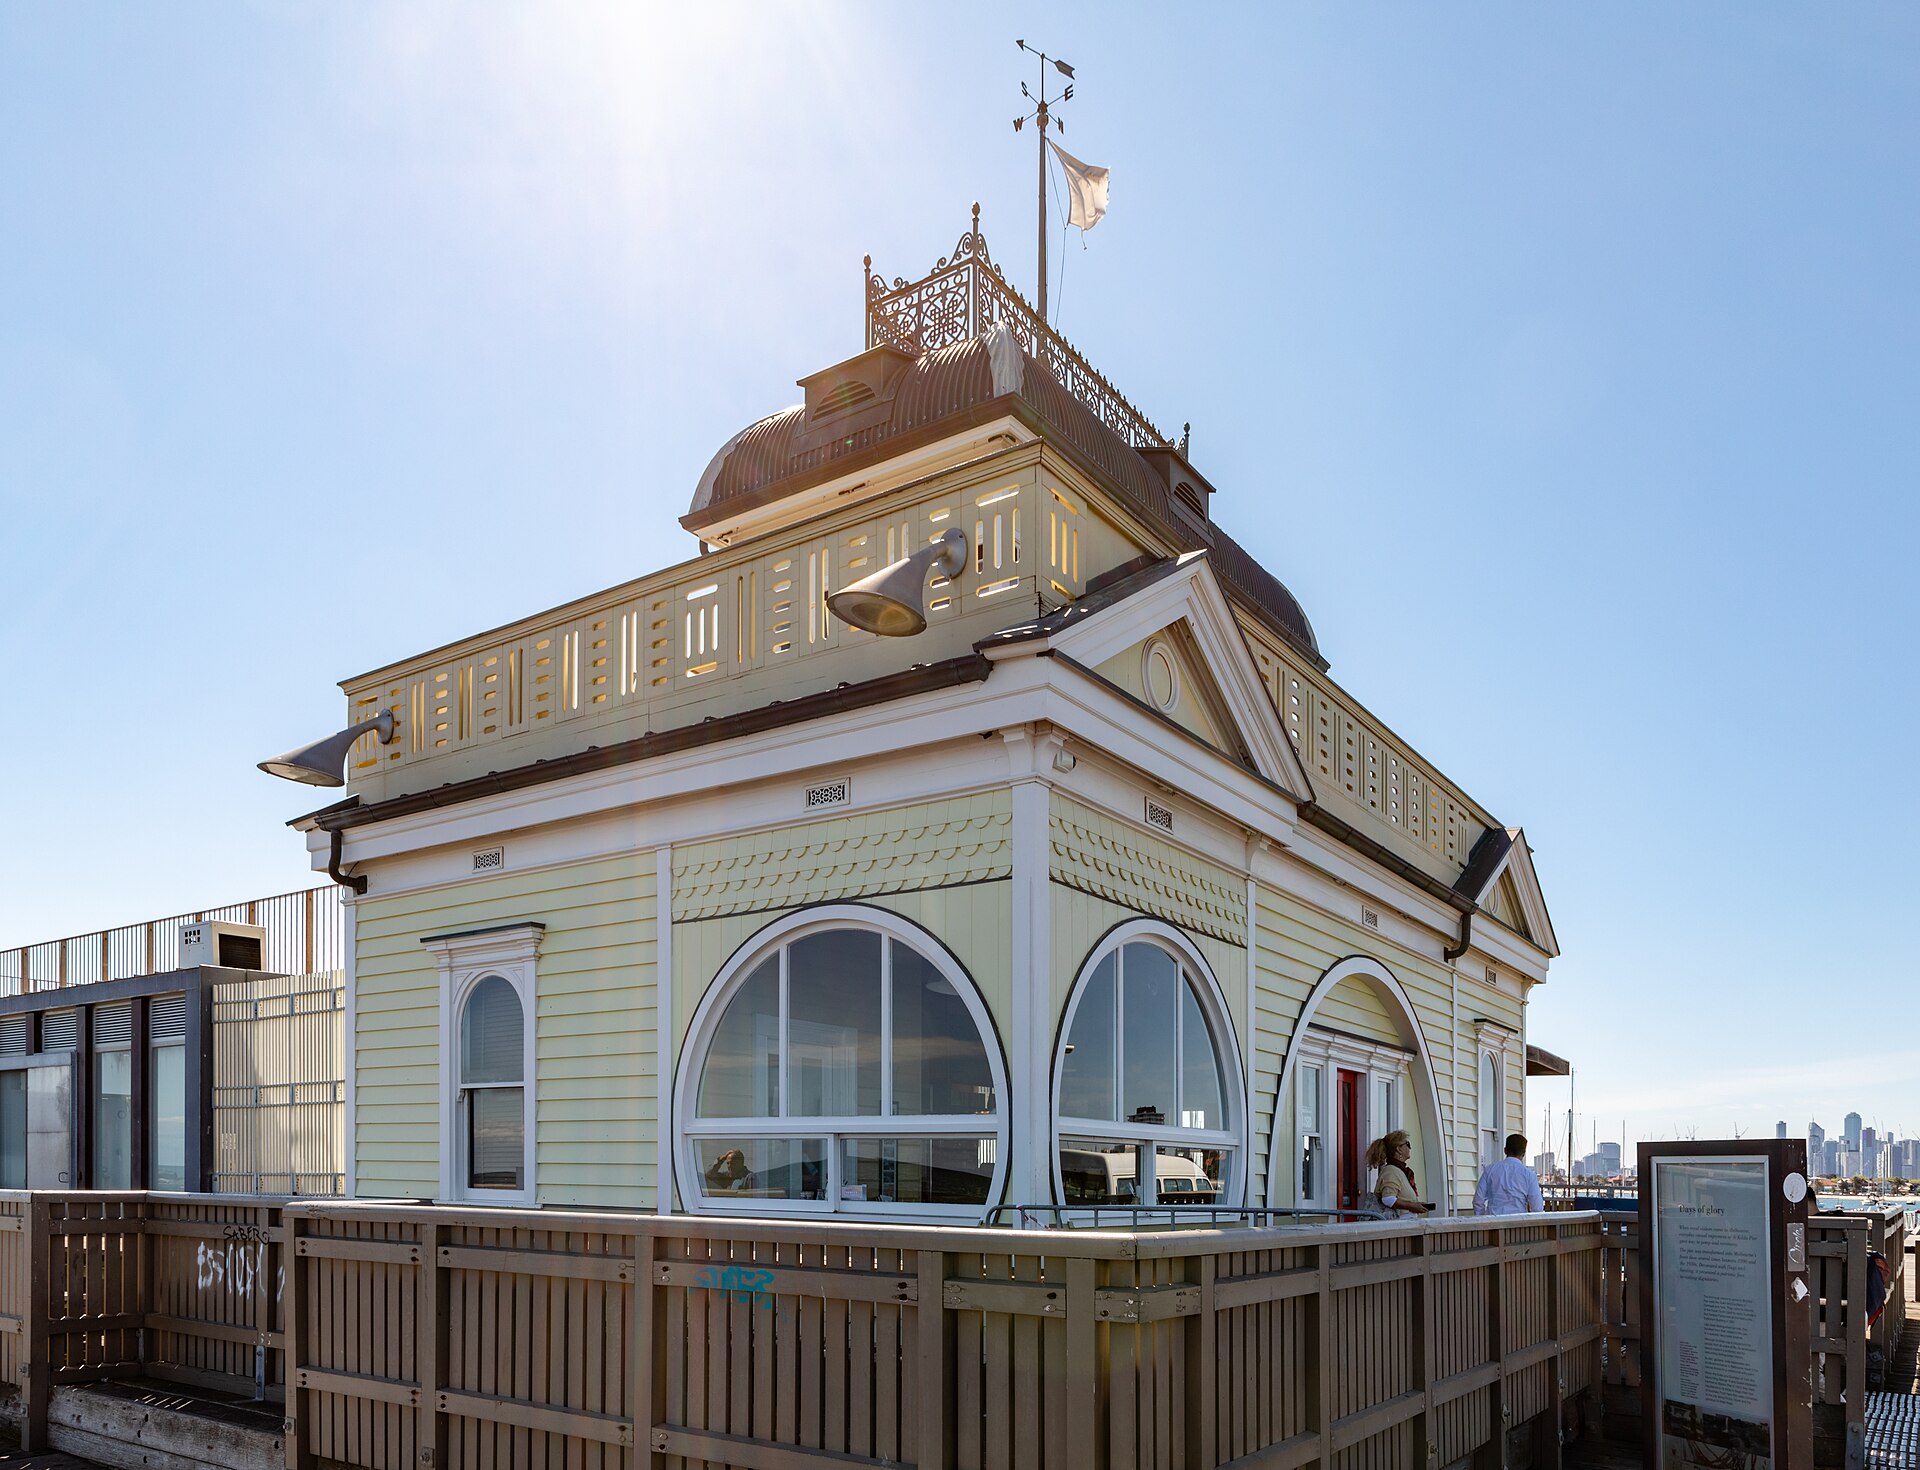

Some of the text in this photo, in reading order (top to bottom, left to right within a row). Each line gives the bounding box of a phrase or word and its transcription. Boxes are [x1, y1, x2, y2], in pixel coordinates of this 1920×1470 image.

[1064, 83, 1074, 102] E
[1013, 116, 1024, 133] W
[1697, 1204, 1706, 1214] of
[1706, 1204, 1725, 1217] glory
